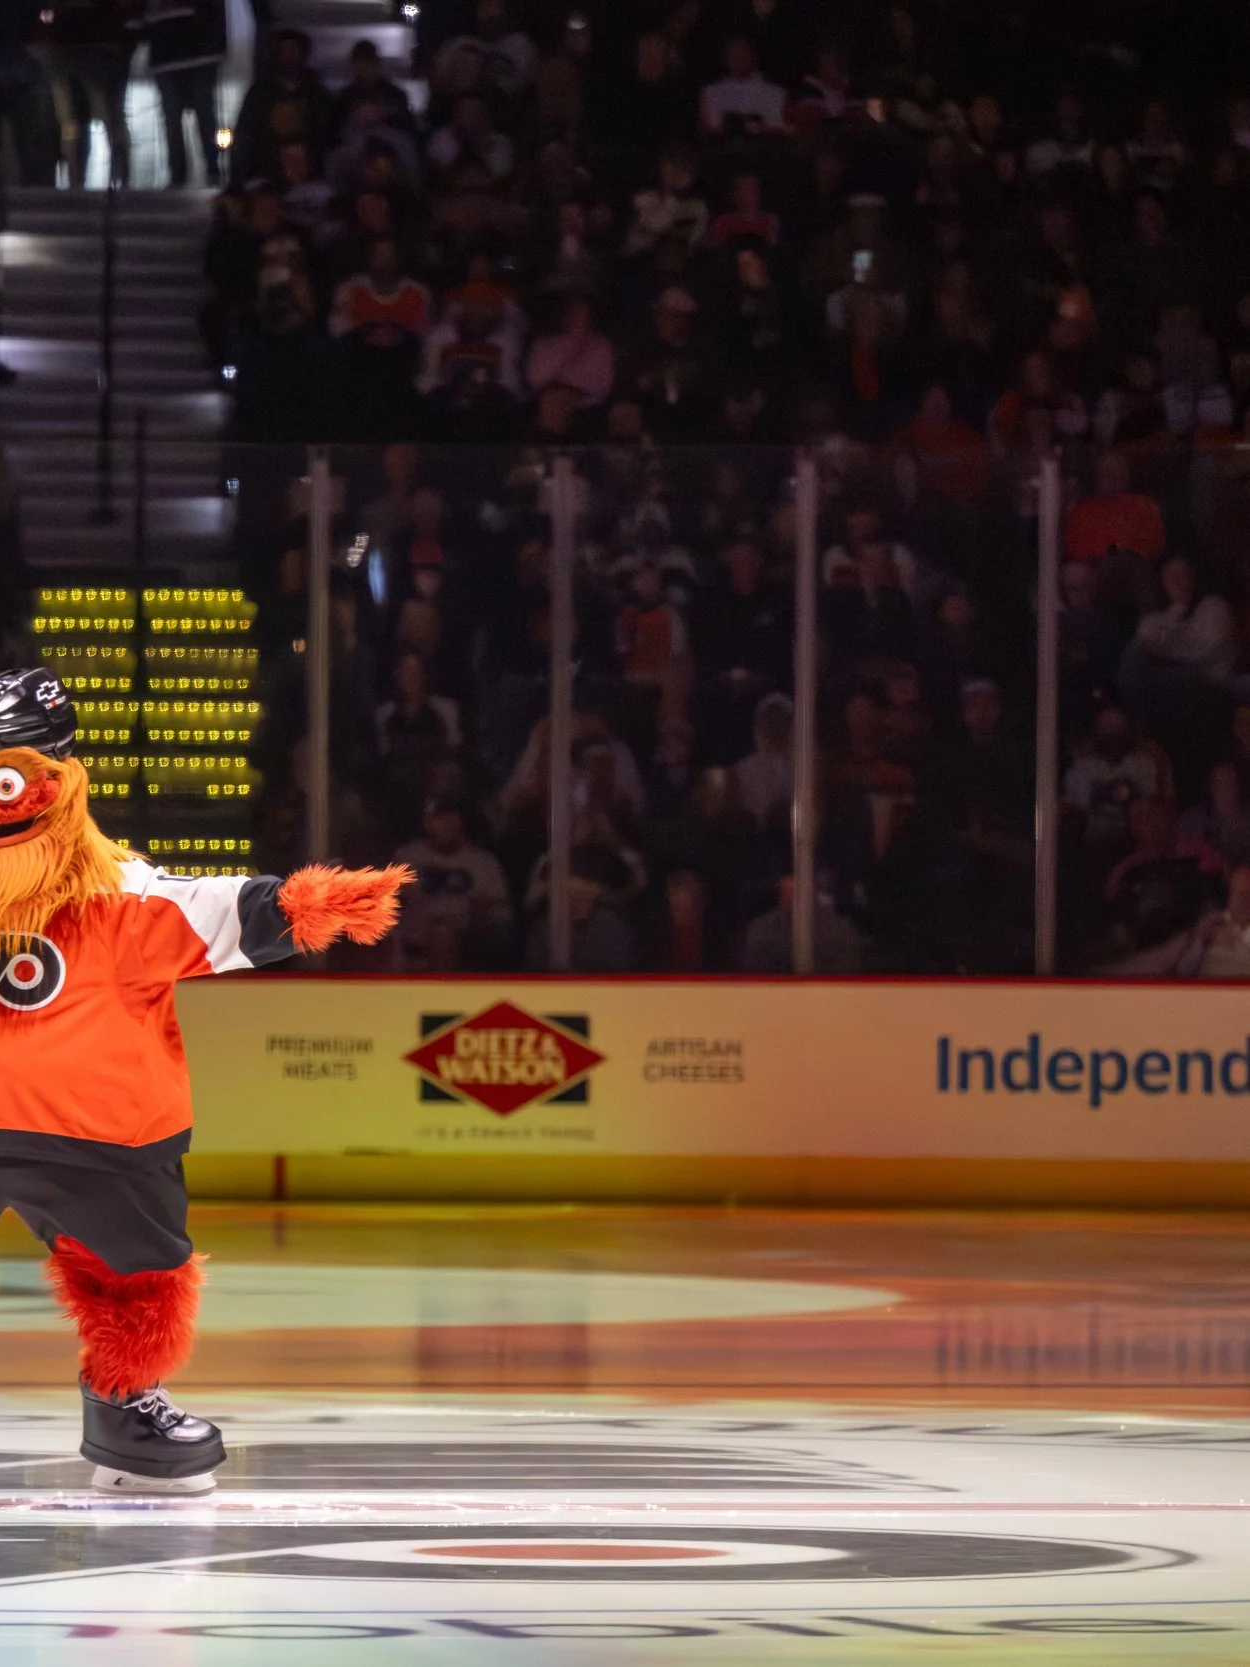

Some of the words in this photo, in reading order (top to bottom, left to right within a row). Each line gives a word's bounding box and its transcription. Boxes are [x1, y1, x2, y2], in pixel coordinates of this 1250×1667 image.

[265, 1034, 375, 1056] PREMIUM
[646, 1037, 744, 1058] ARTISAN
[282, 1060, 358, 1081] MEATS
[435, 1055, 568, 1085] WATSON
[643, 1062, 746, 1084] CHEESES
[937, 1032, 1250, 1109] Independ
